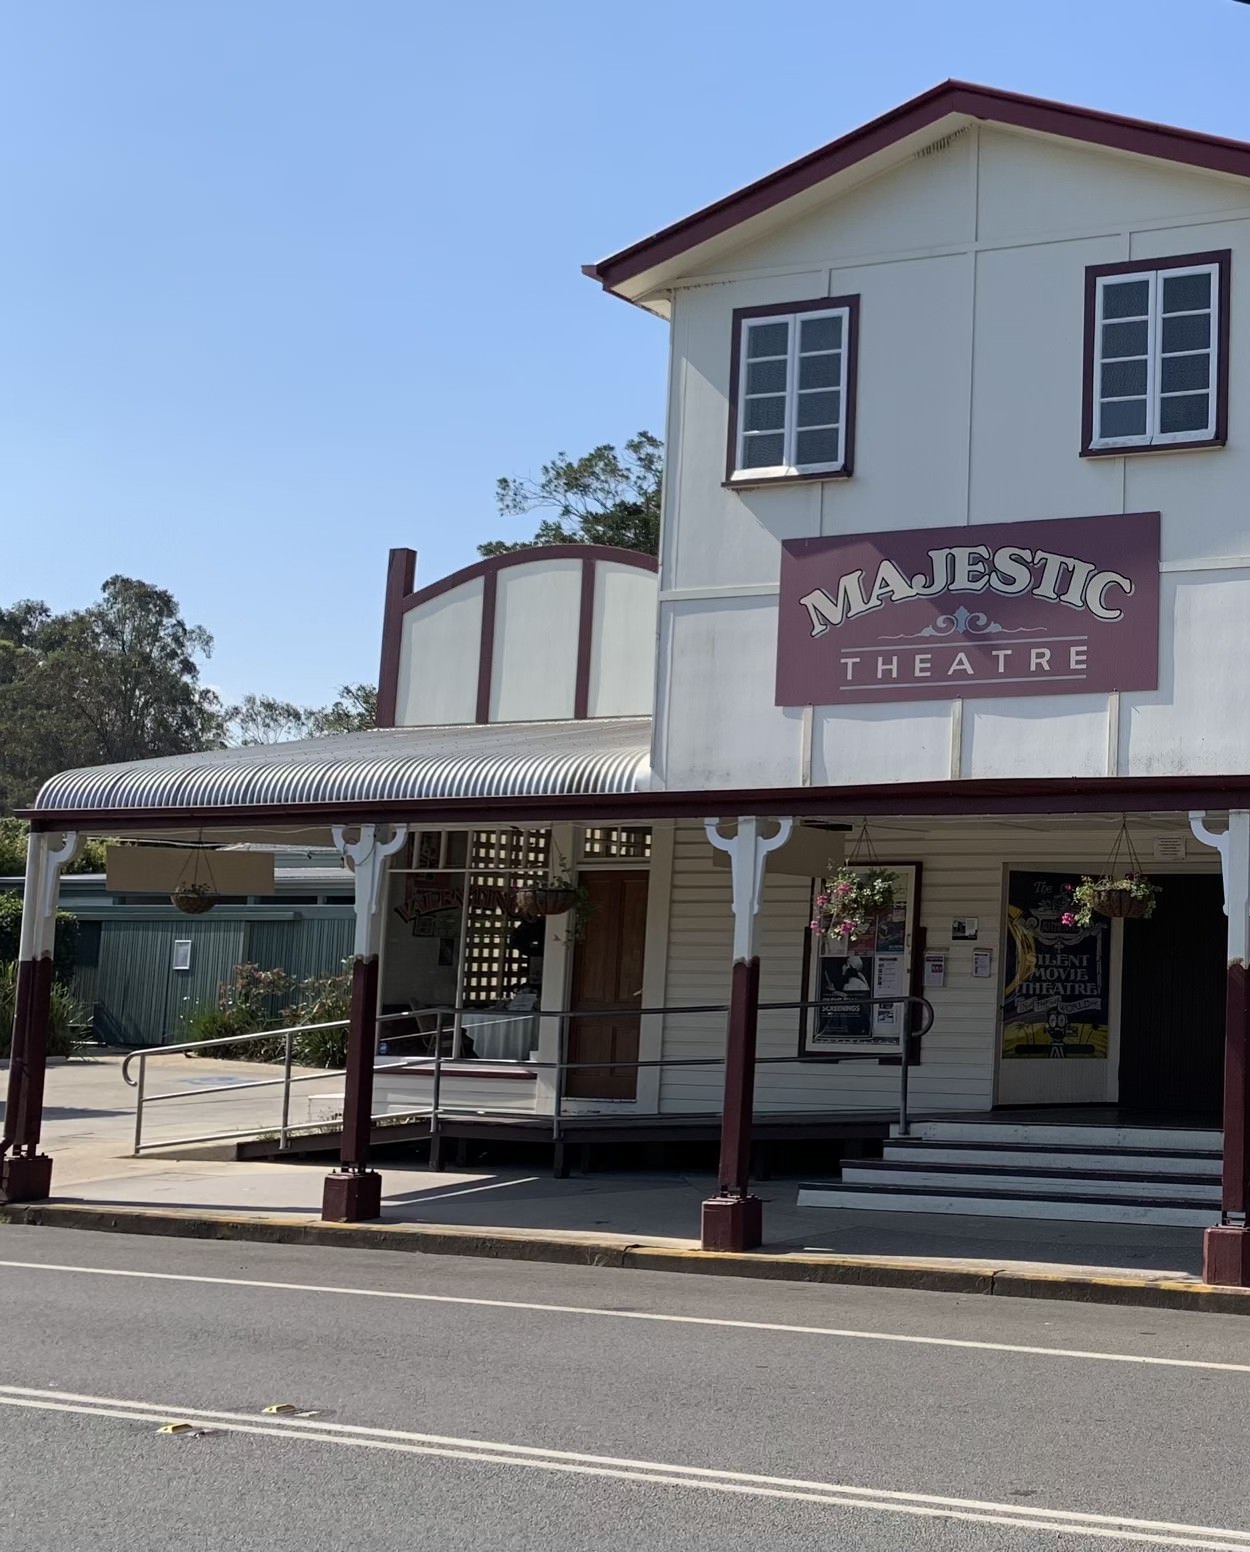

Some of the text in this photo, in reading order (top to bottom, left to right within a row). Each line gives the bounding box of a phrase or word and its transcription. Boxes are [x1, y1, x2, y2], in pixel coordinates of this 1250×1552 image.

[800, 545, 1134, 638] MAJESTIC
[840, 645, 1088, 681] THEATRE
[1033, 880, 1053, 894] The
[1025, 953, 1090, 967] SILENT
[1029, 967, 1089, 981] MOVIE
[1020, 982, 1098, 996] THEATRE
